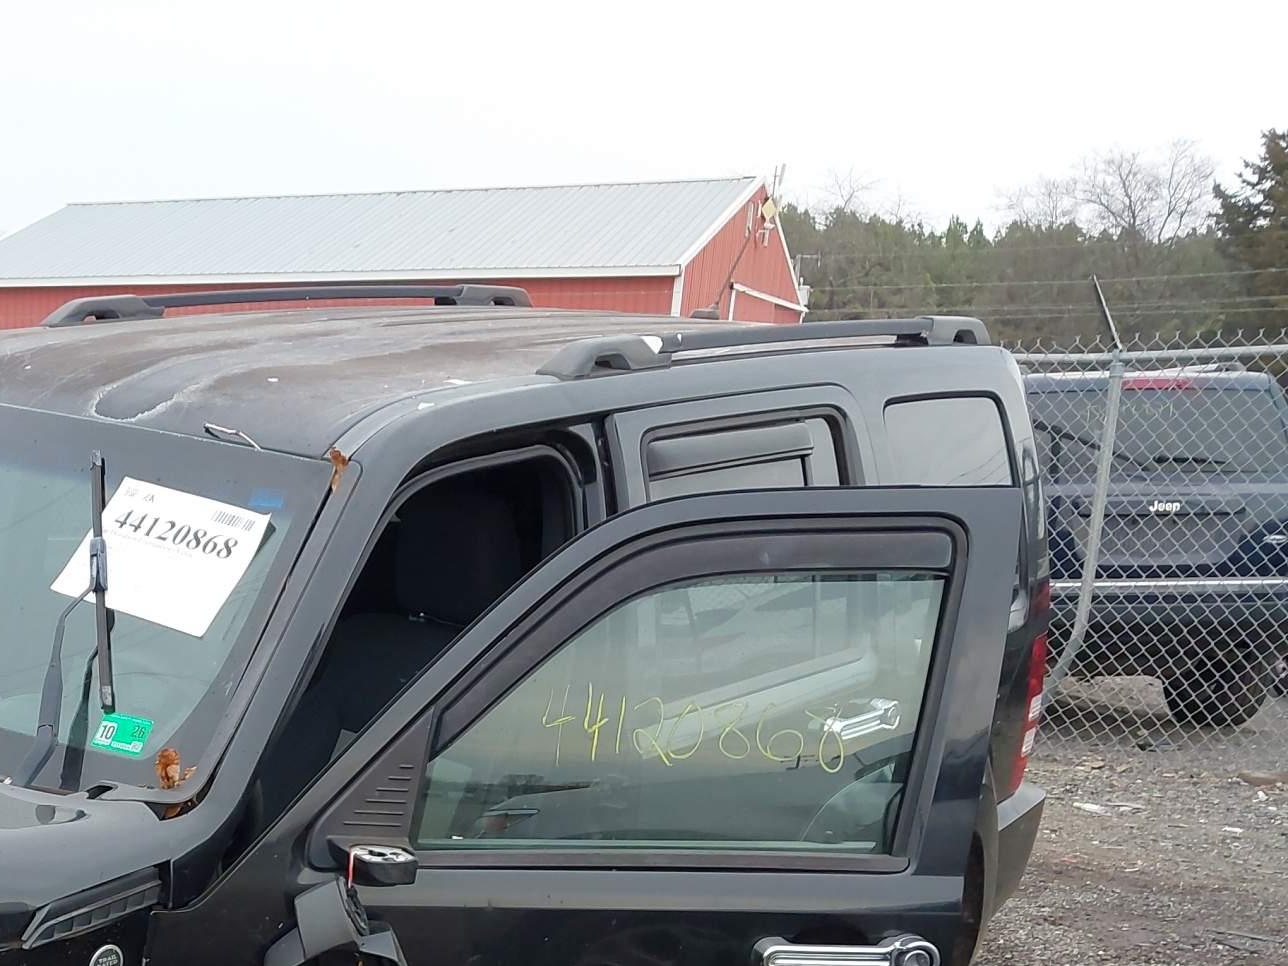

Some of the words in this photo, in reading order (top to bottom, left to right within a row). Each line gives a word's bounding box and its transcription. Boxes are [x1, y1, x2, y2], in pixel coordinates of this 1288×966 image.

[1149, 500, 1181, 512] Jeep
[114, 509, 238, 559] 44120868
[99, 724, 115, 740] 10
[132, 725, 147, 739] 26
[542, 682, 844, 773] 44120868
